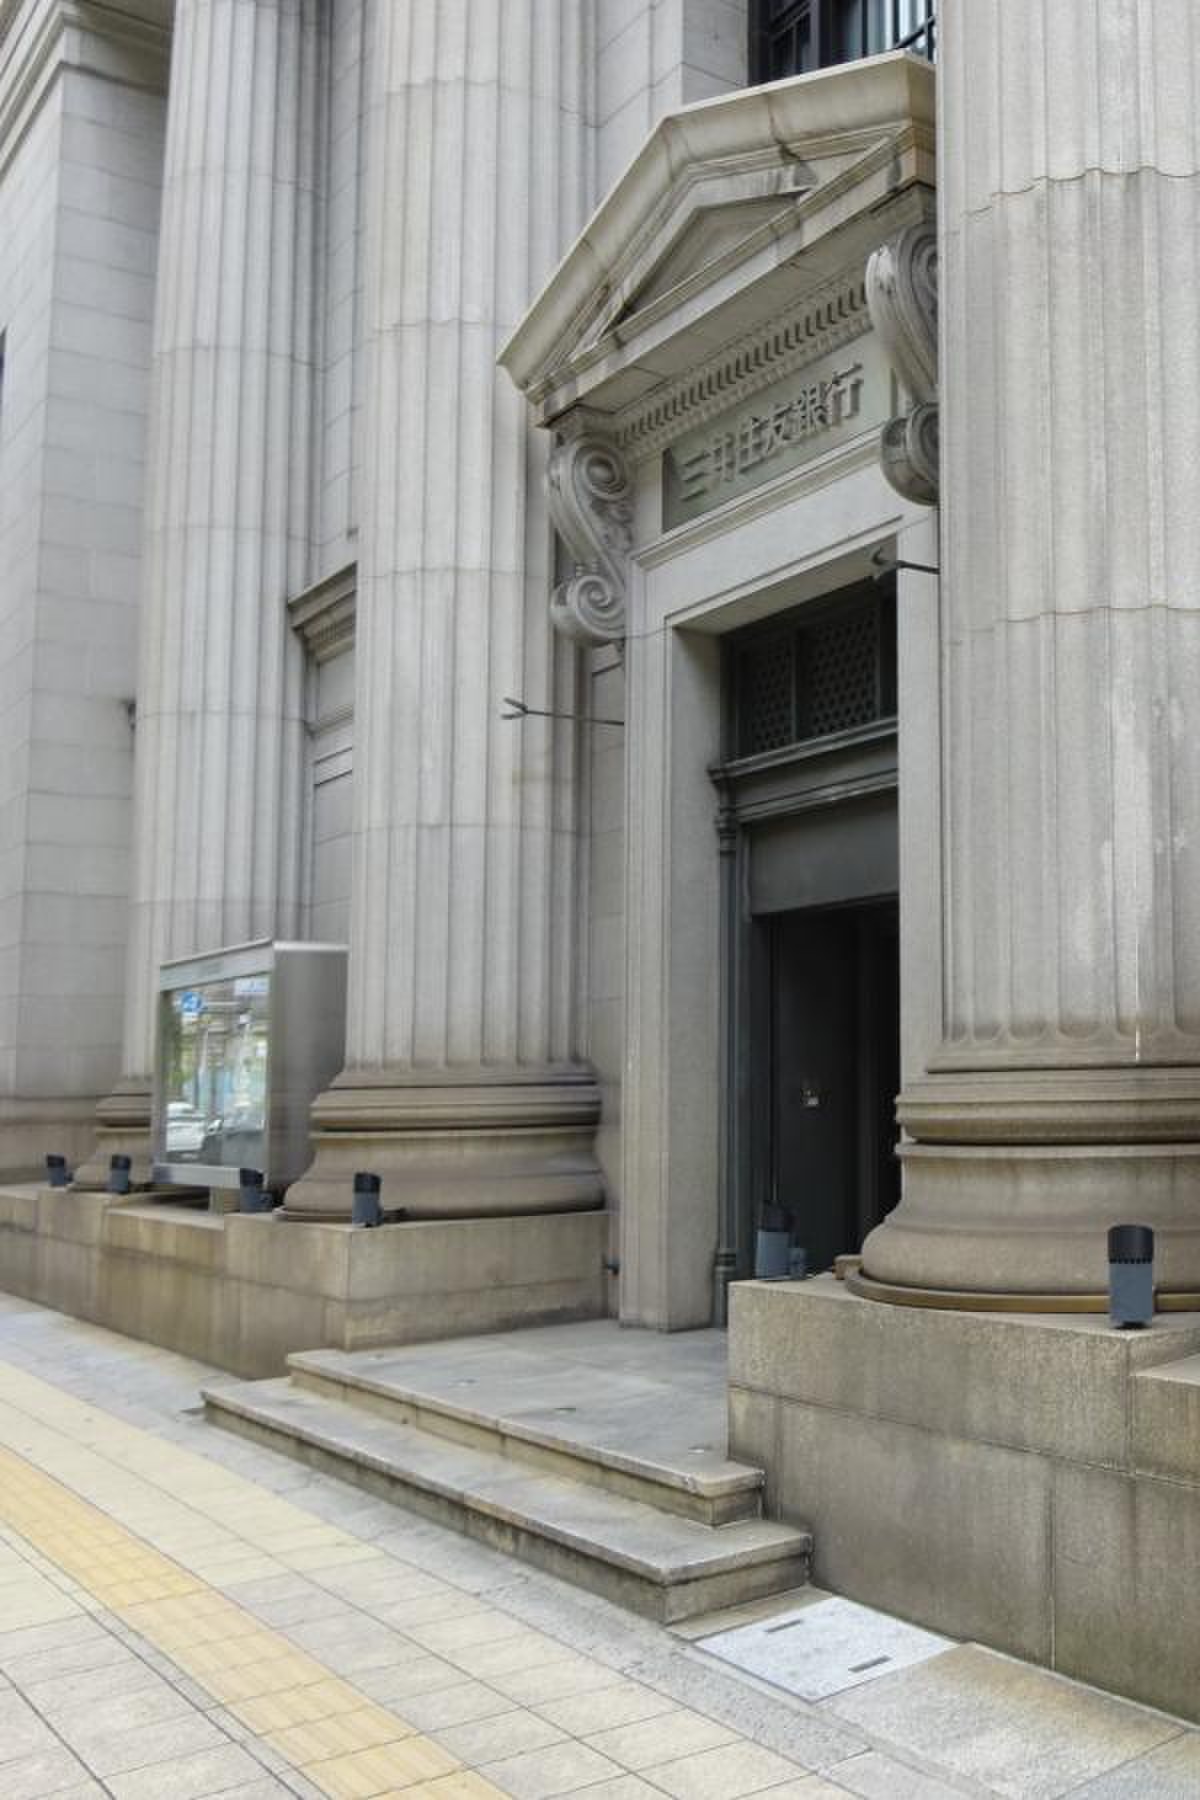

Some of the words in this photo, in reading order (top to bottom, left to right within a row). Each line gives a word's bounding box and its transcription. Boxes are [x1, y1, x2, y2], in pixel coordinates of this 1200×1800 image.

[680, 363, 865, 503] 三井住友銀行
